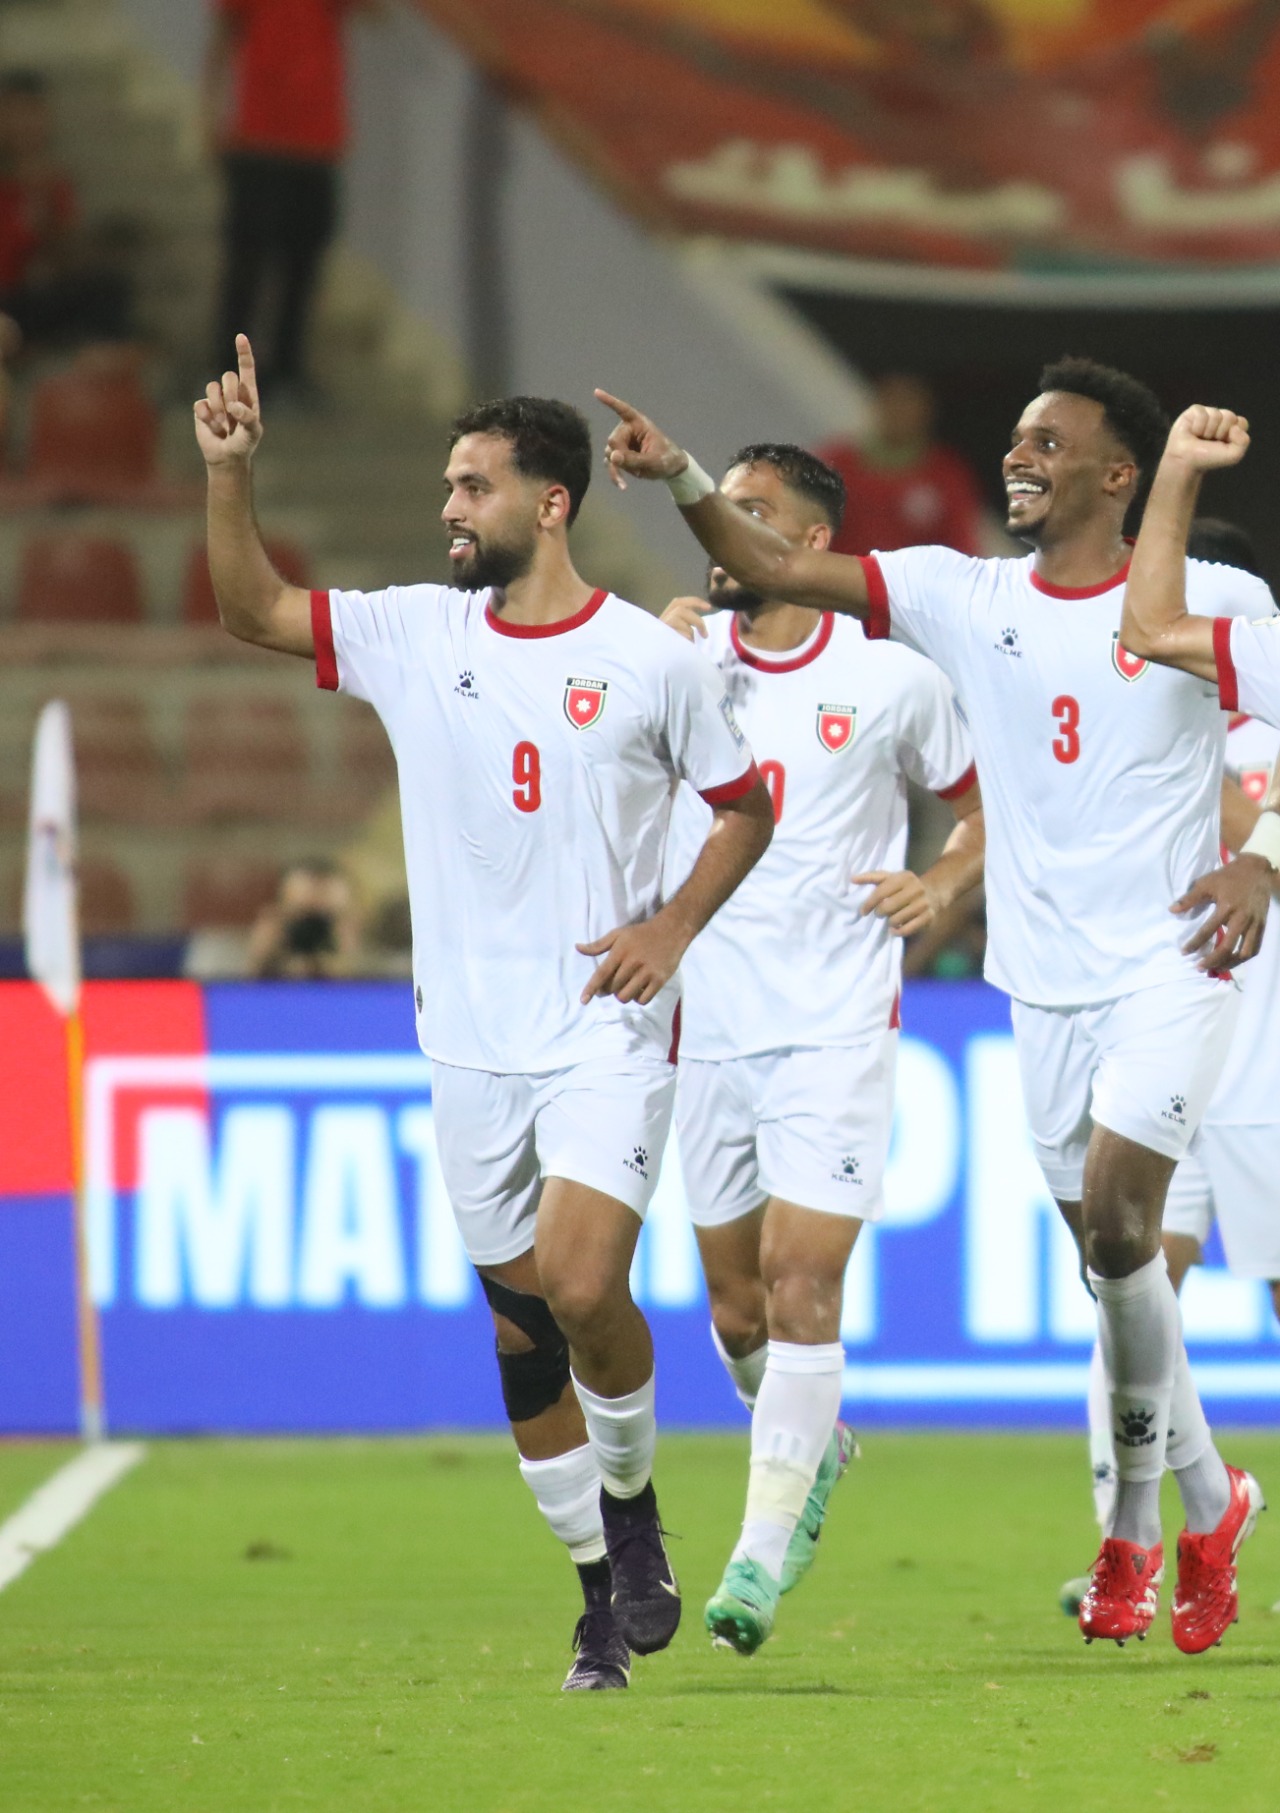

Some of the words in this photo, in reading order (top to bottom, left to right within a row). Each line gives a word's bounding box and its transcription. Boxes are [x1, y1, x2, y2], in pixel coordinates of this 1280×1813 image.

[571, 678, 604, 690] JORDAN
[822, 704, 853, 713] JORDAN
[1051, 695, 1080, 764] 3
[512, 740, 541, 813] 9
[1161, 1110, 1187, 1126] KELME
[623, 1158, 648, 1180] KELME
[831, 1173, 864, 1185] KELME
[135, 1102, 702, 1310] MAT
